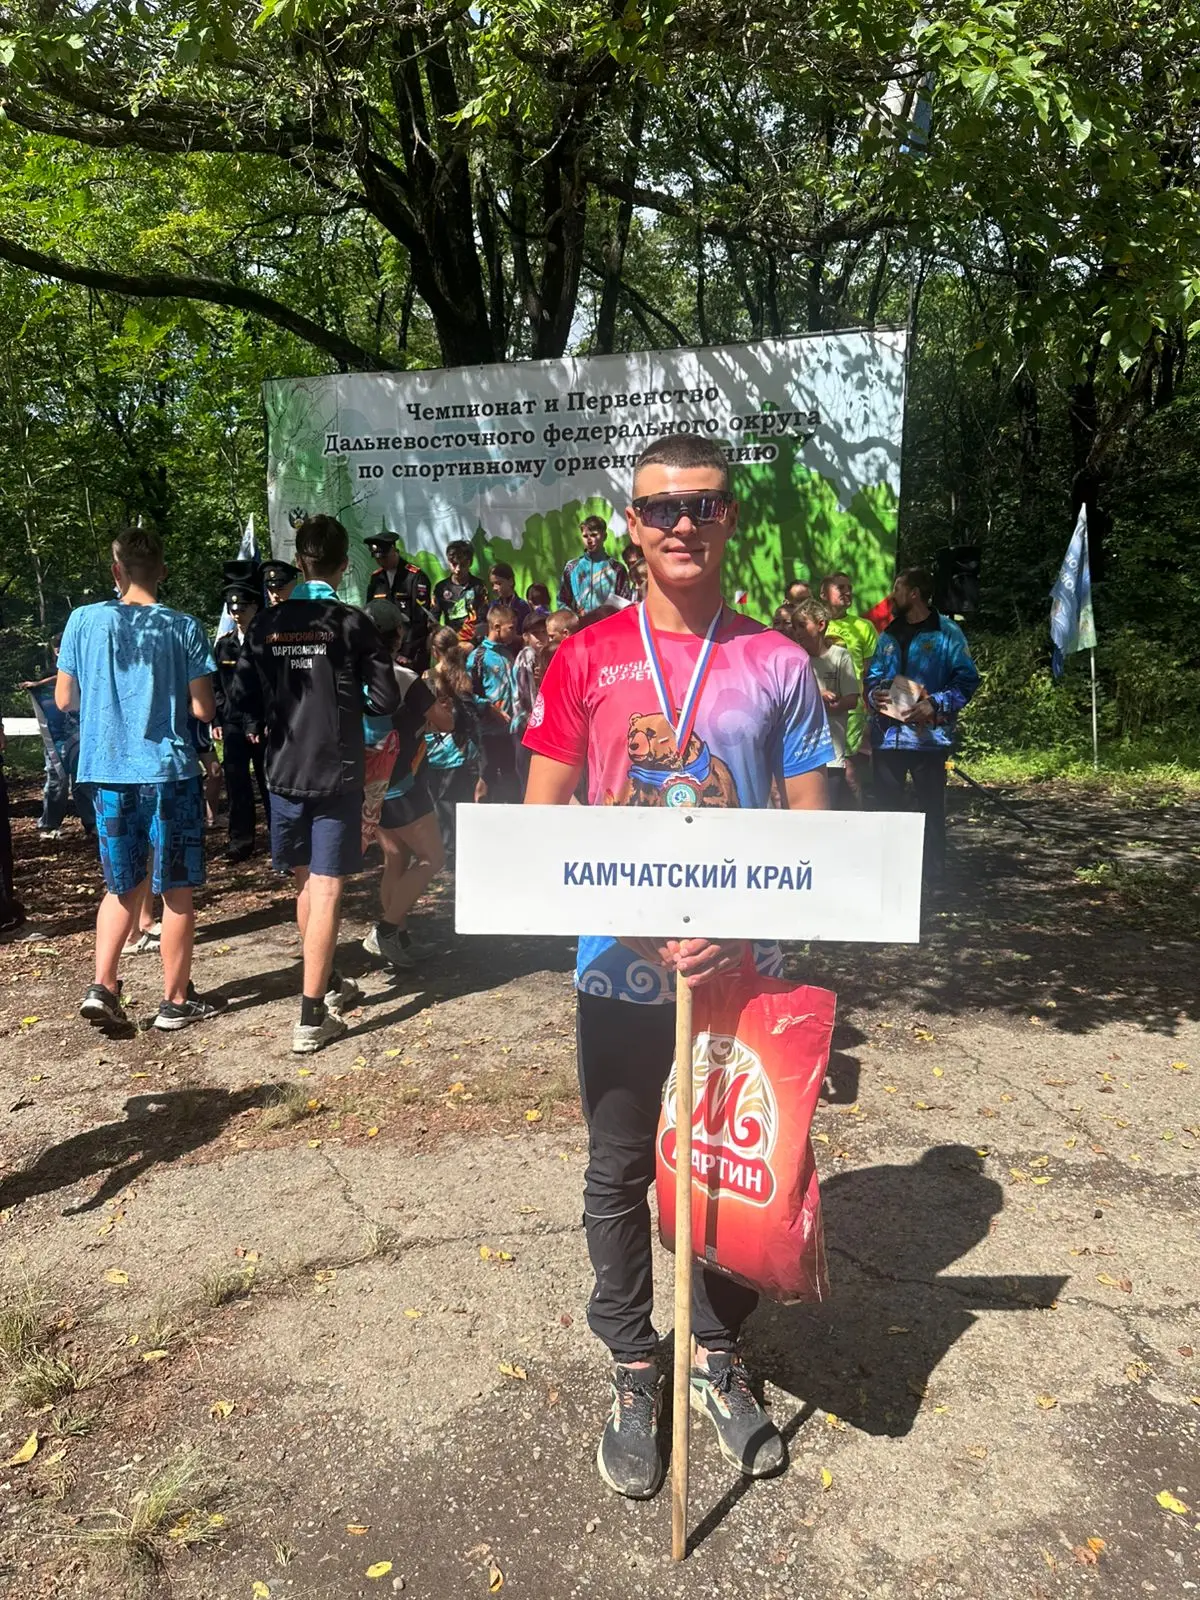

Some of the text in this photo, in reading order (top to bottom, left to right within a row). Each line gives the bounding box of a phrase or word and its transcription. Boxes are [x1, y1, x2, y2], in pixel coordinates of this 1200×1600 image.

[406, 387, 719, 421] Чемпионат и Первенство
[324, 411, 821, 454] Дальневосточного федерального округа
[359, 445, 777, 481] по спортивному ориентнию
[272, 643, 327, 656] ПАРТИЗАНСКИЙ
[291, 656, 313, 669] РАЙОН
[600, 660, 652, 677] RUSSIA
[563, 858, 813, 890] КАМЧАТСКИЙ КРАЙ
[672, 1145, 763, 1193] АРТИН
